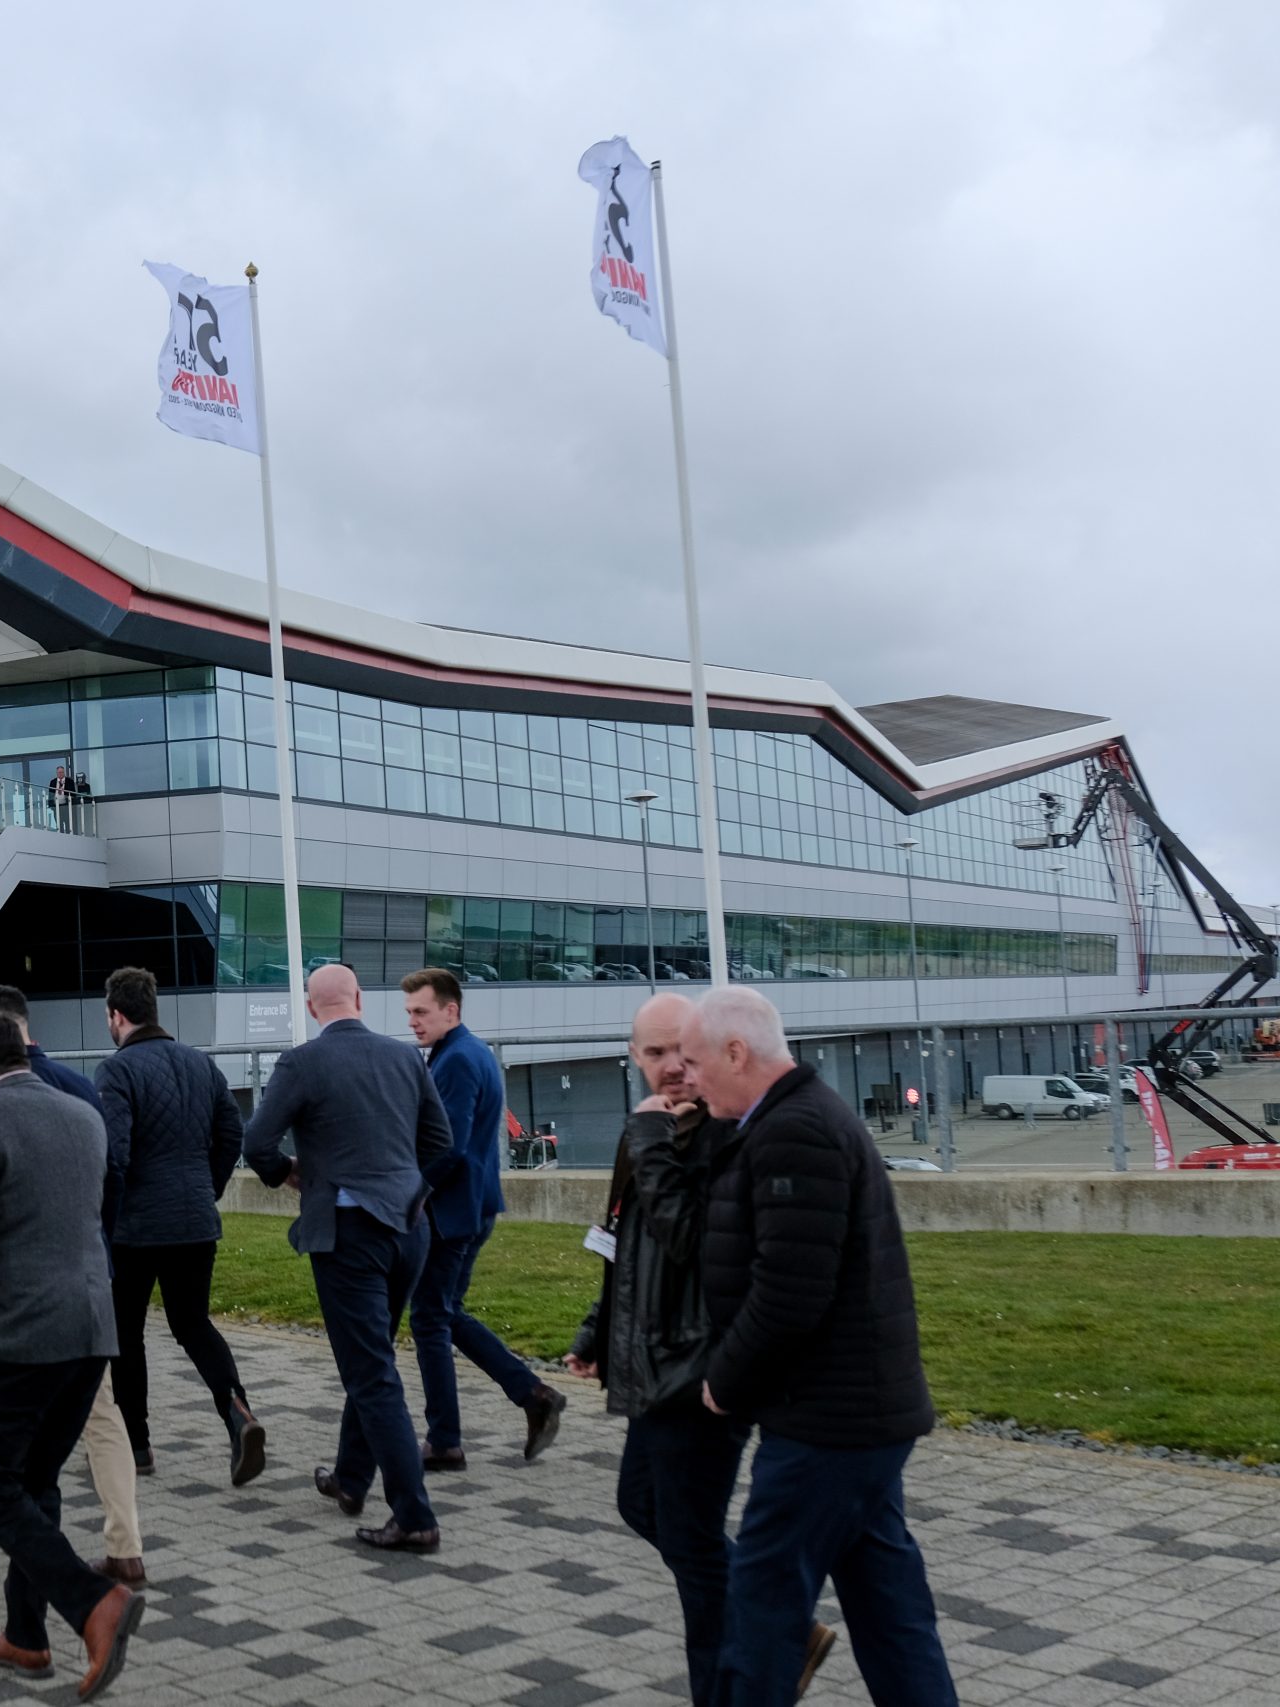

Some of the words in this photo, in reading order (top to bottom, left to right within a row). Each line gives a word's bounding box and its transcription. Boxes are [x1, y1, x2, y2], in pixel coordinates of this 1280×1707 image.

[249, 1004, 279, 1017] Entrance
[279, 1003, 288, 1016] 05
[561, 1075, 571, 1089] 04
